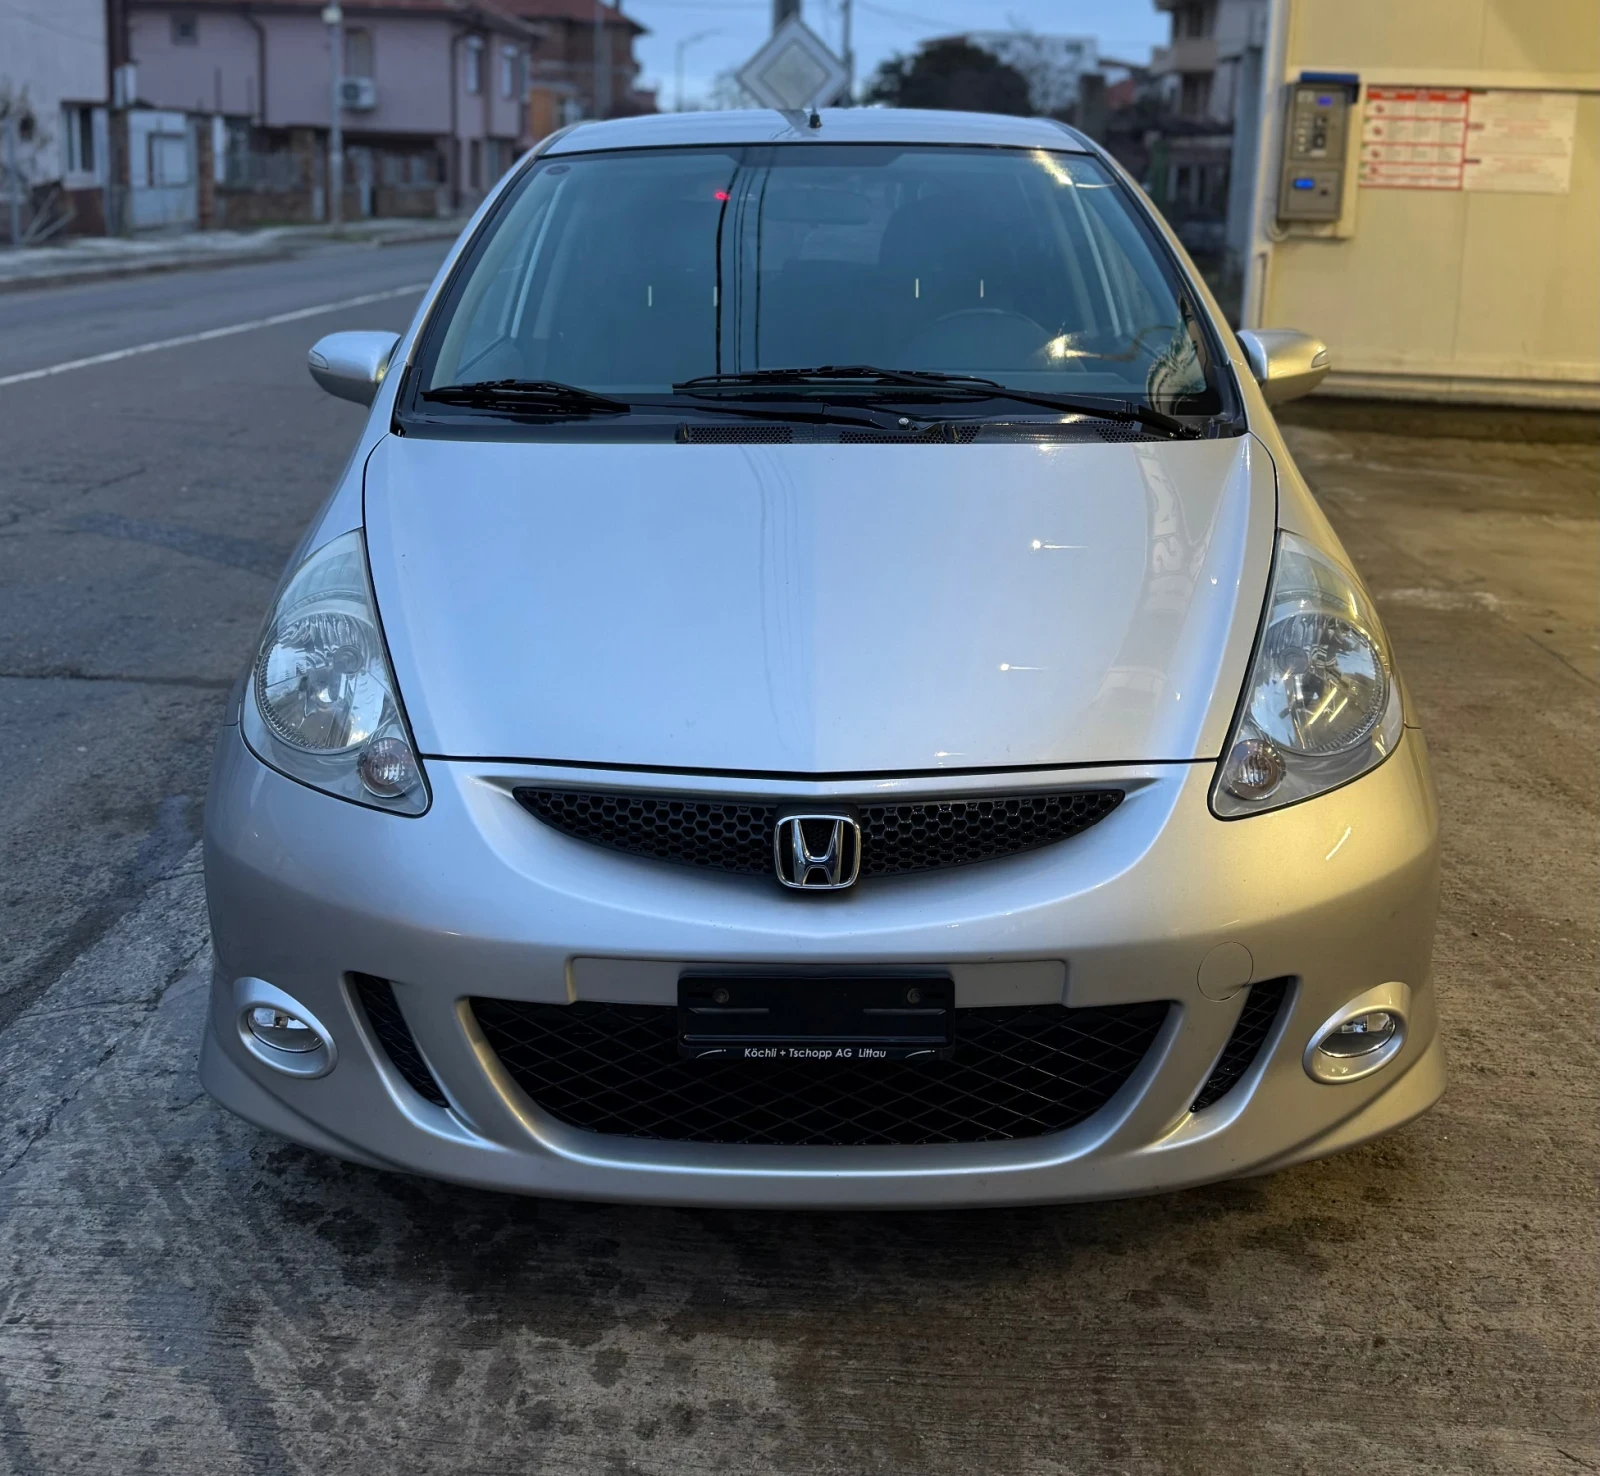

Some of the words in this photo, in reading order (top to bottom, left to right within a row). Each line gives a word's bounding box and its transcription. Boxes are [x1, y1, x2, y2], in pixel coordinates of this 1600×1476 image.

[744, 1048, 778, 1058] Köchli
[788, 1048, 833, 1060] Tschopp
[835, 1048, 853, 1058] AG
[858, 1048, 887, 1058] Littau
